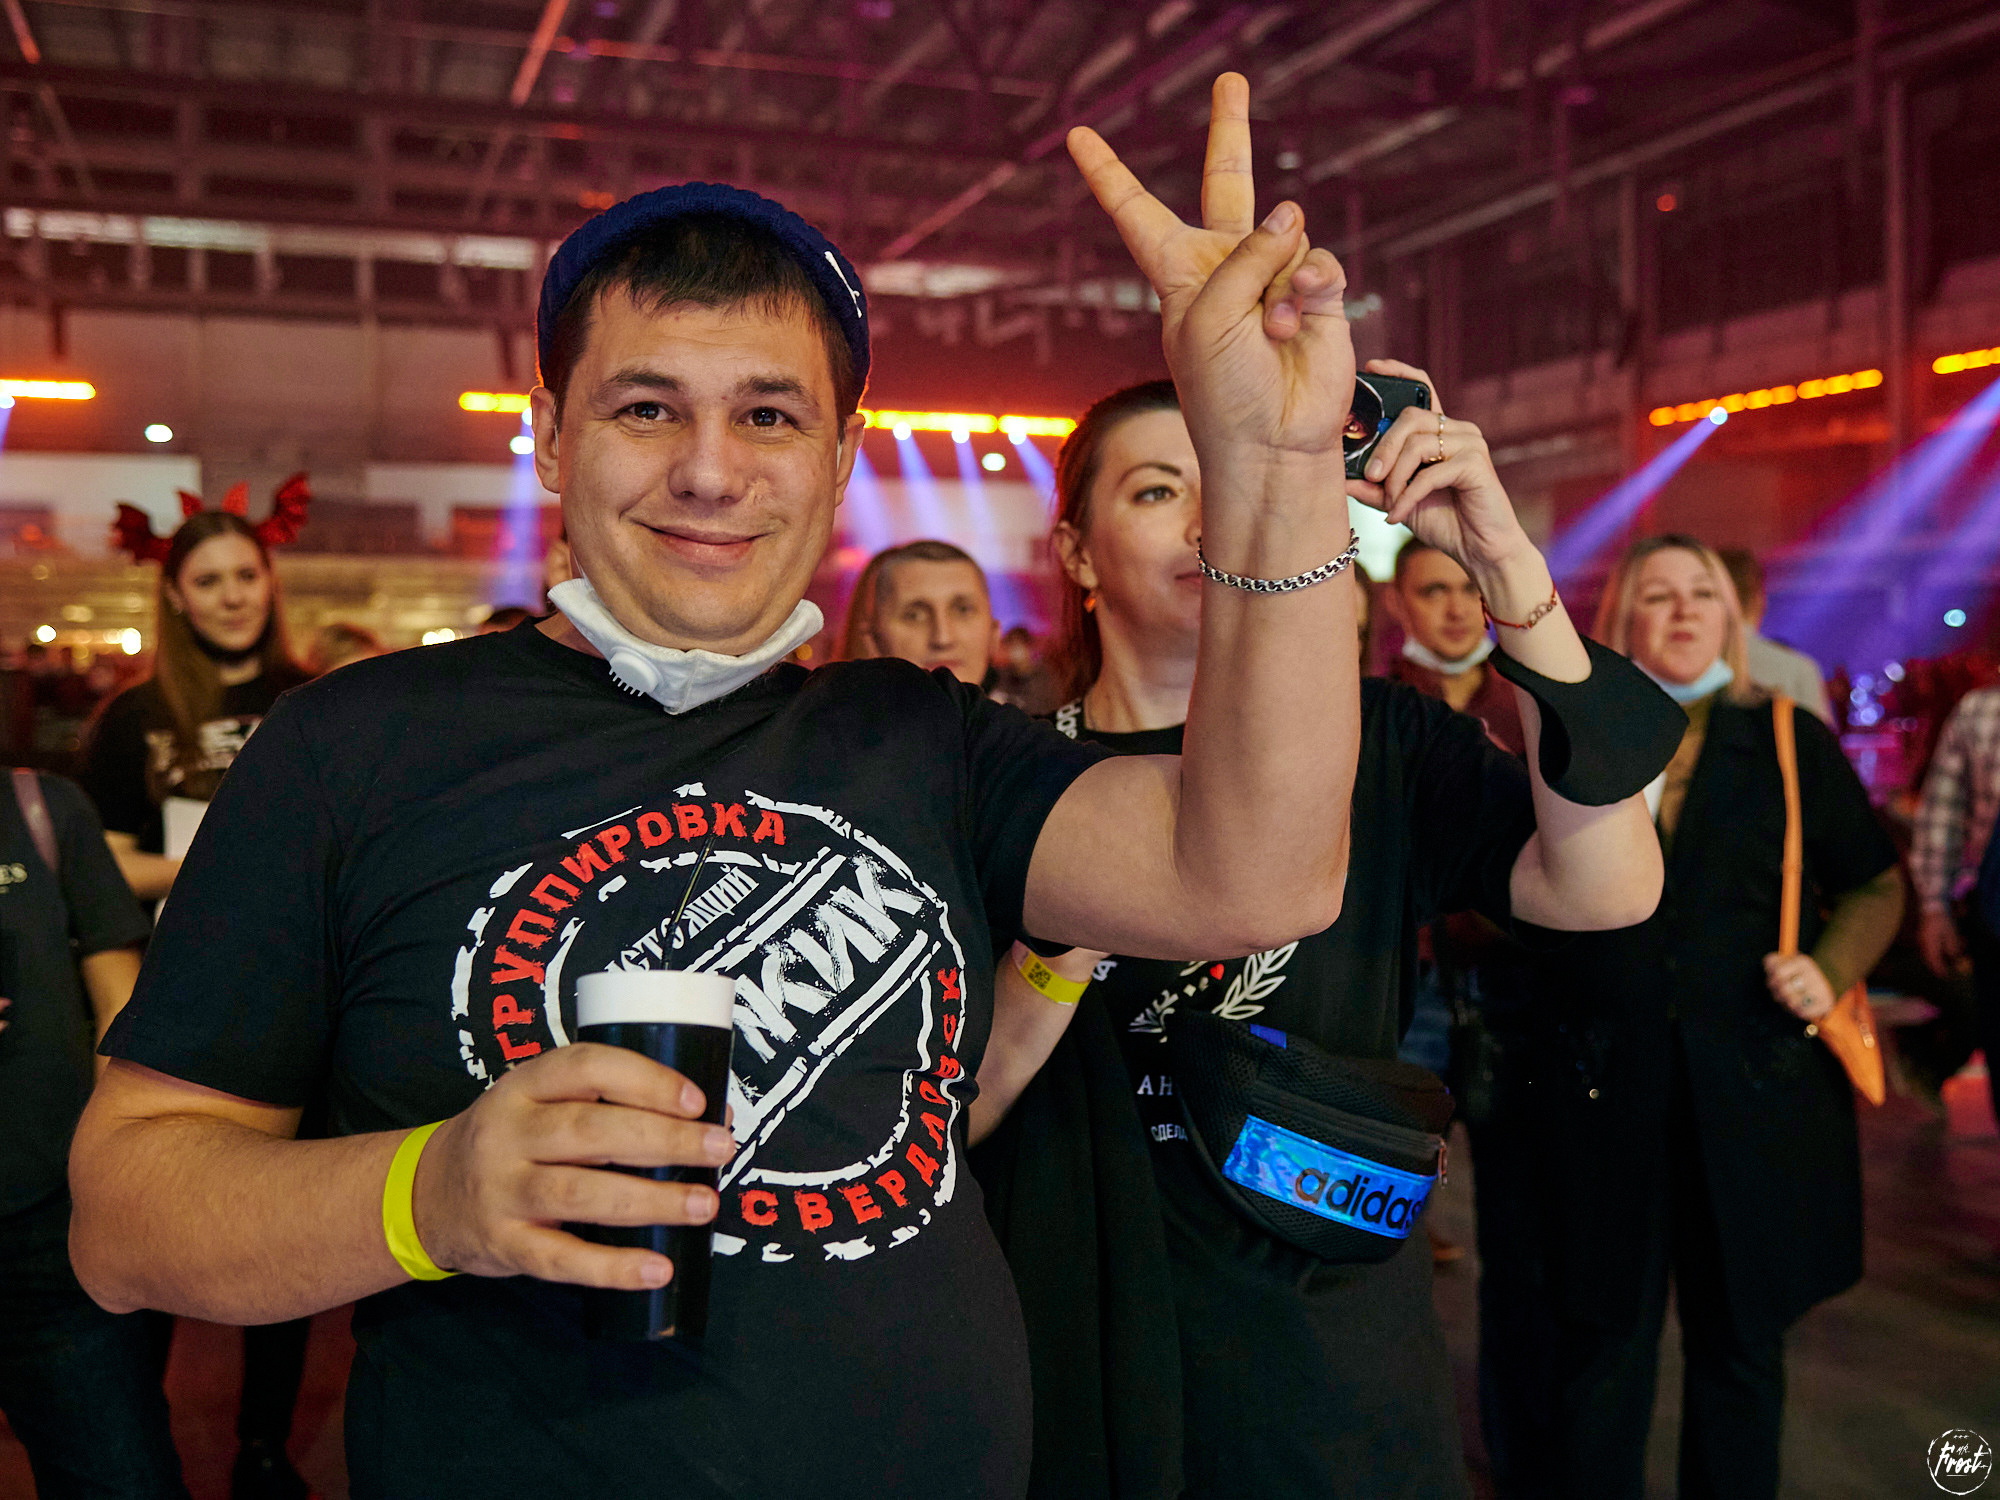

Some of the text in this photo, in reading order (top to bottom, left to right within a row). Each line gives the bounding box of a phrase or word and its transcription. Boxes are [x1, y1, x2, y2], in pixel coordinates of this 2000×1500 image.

[490, 801, 787, 1061] ГРУППИРОВКА
[603, 863, 760, 972] СТОЯЩИЙ
[729, 850, 931, 1063] ЖИК
[740, 966, 961, 1236] СВЕРДЛОВСК
[1295, 1167, 1423, 1230] adidas
